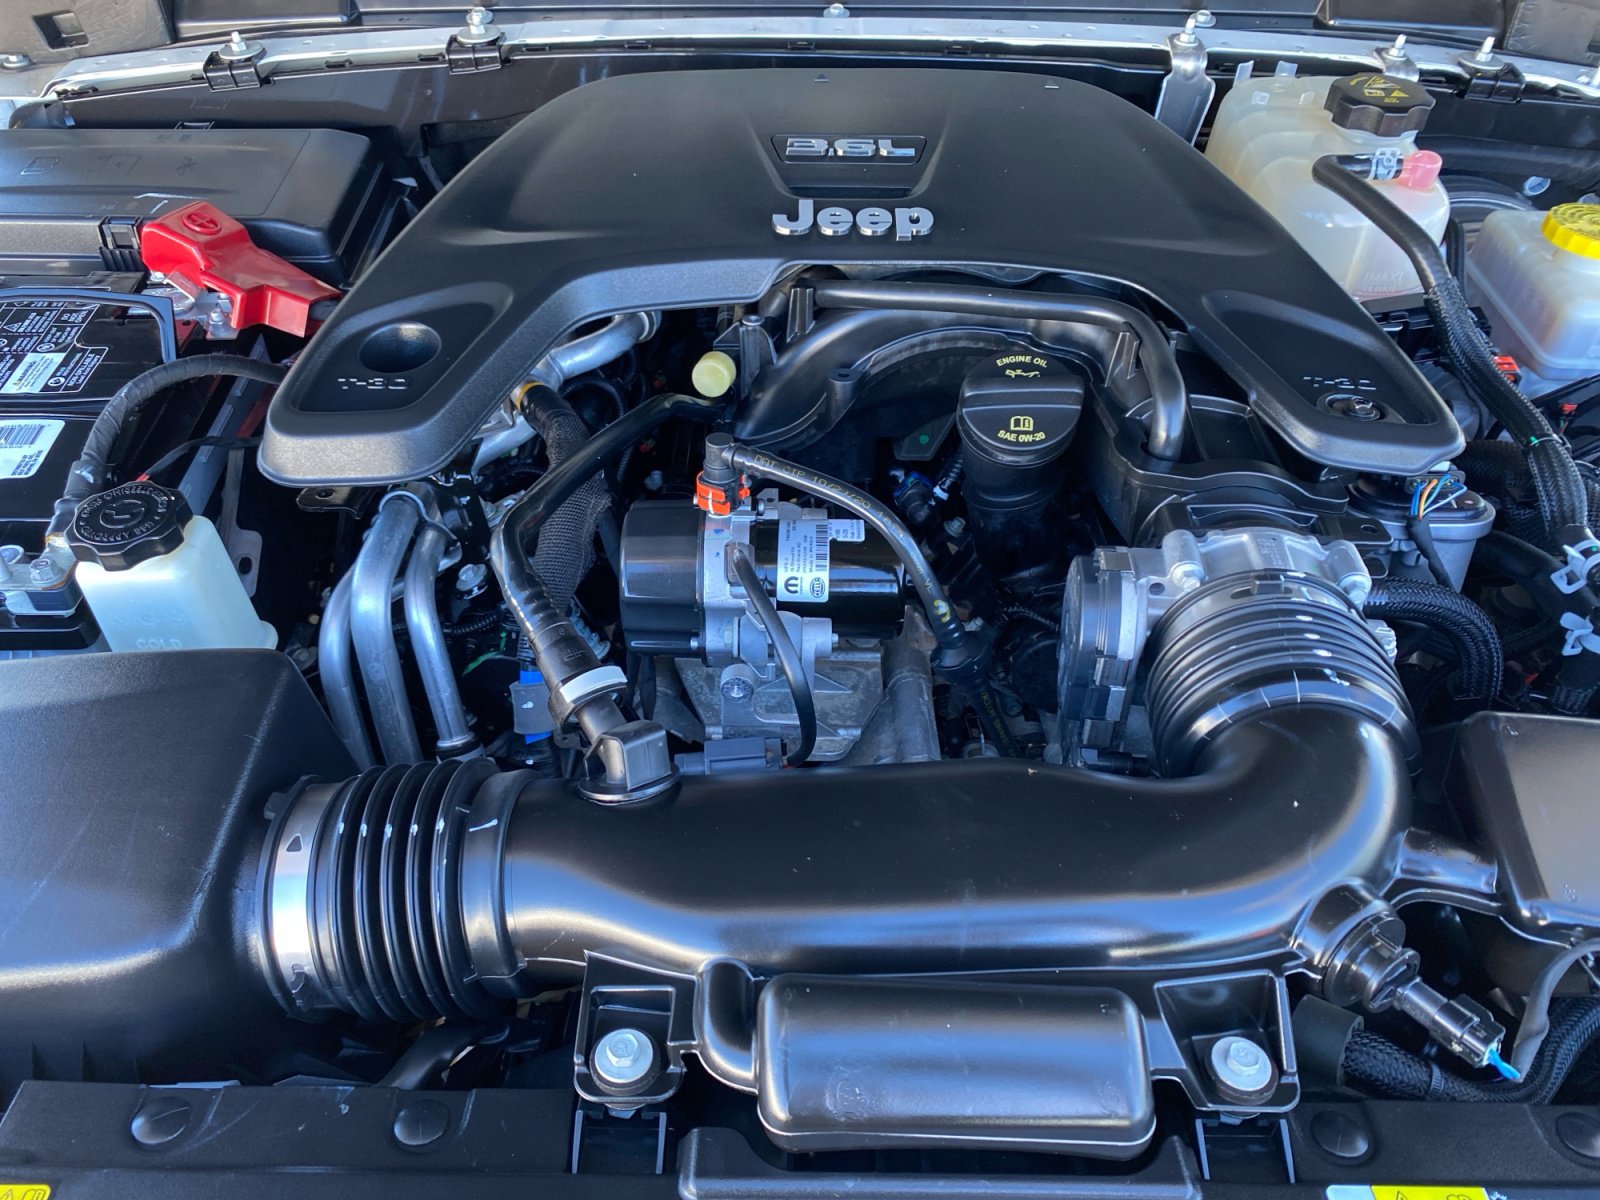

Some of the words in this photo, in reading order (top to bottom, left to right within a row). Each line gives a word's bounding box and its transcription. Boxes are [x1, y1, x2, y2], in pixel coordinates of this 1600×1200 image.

[785, 137, 916, 157] 3.6L
[772, 199, 935, 242] Jeep
[995, 355, 1032, 367] ENGINE
[1033, 356, 1048, 368] OIL
[997, 429, 1017, 442] SAE
[1018, 431, 1046, 442] 0W-20
